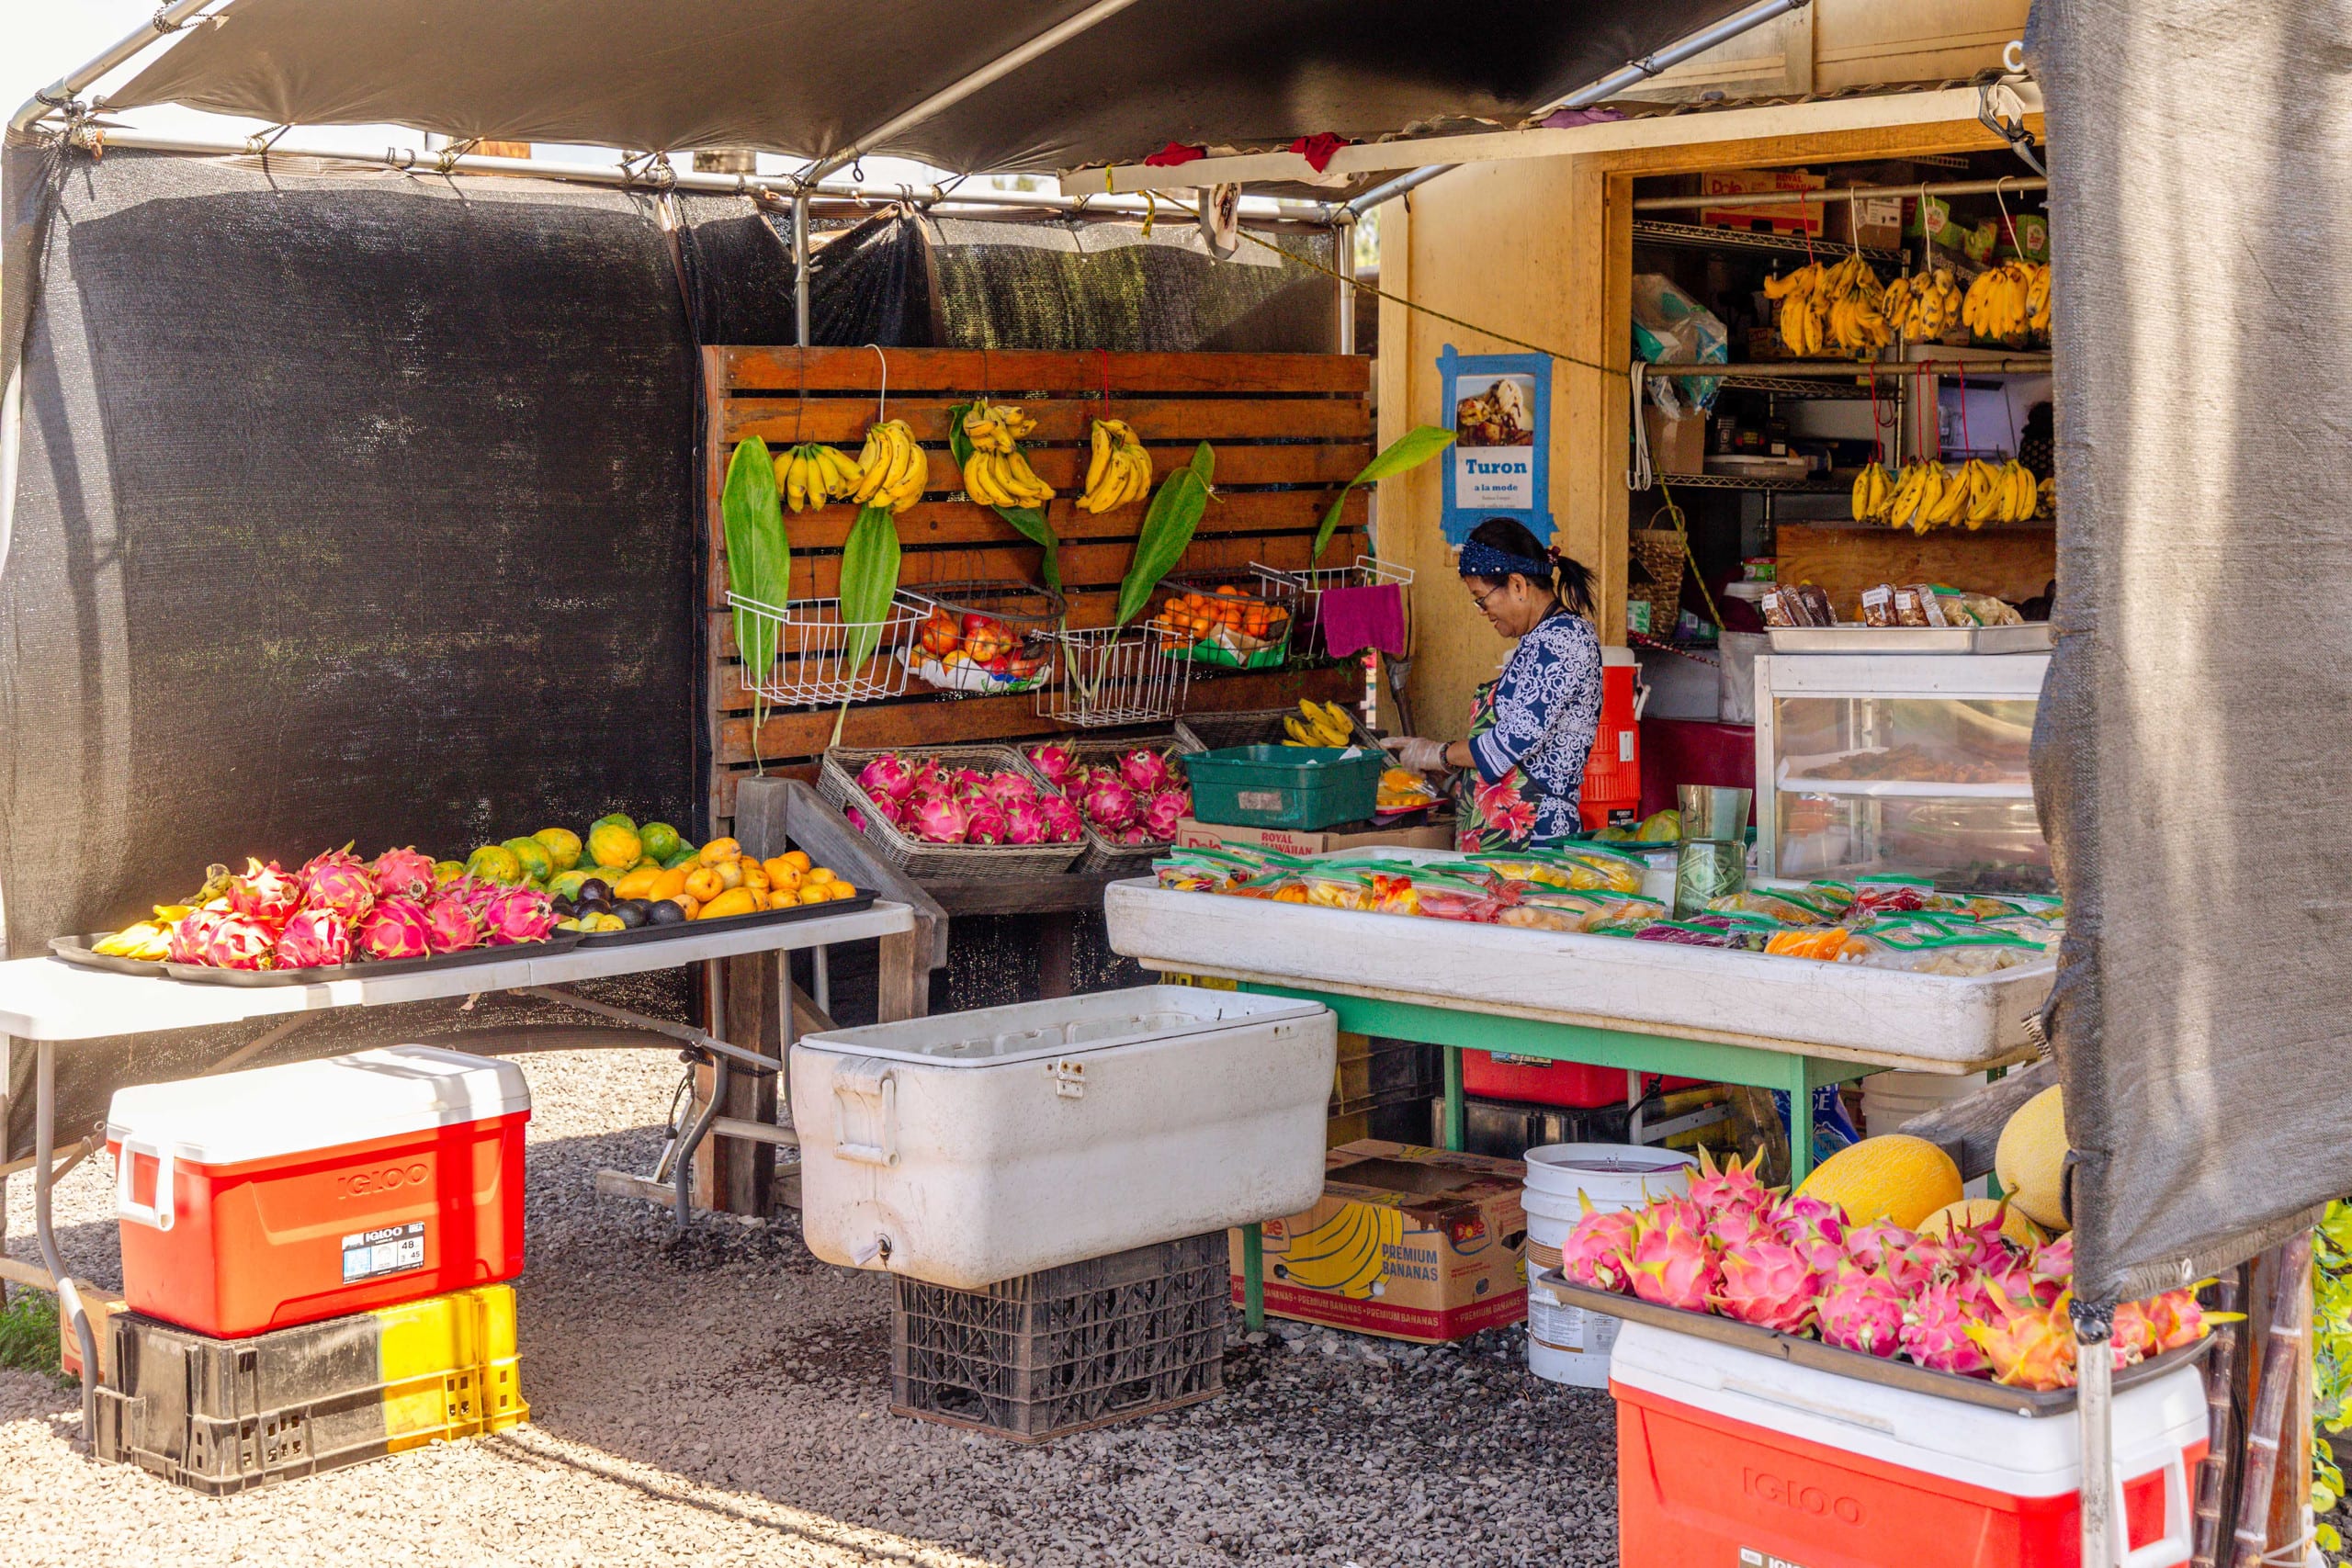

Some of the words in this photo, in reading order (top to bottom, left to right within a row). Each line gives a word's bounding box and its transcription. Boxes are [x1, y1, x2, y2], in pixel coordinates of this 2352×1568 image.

[1465, 458, 1527, 474] Turon
[1481, 483, 1490, 491] la
[1492, 483, 1519, 491] mode
[1261, 832, 1293, 844] ROYAL
[337, 1163, 429, 1200] IGLOO
[366, 1226, 402, 1243] IGLOO
[1454, 1220, 1485, 1241] Dole
[401, 1240, 414, 1250] 48
[411, 1250, 421, 1258] 45
[1382, 1243, 1438, 1265] PREMIUM
[1382, 1260, 1439, 1282] BANANAS
[1297, 1294, 1329, 1309] PREMIUM
[1329, 1300, 1363, 1314] BANANAS
[1366, 1307, 1400, 1322] PREMIUM
[1400, 1313, 1439, 1327] BANANAS
[1460, 1305, 1493, 1323] PREMIUM
[1743, 1466, 1868, 1529] IGLOO
